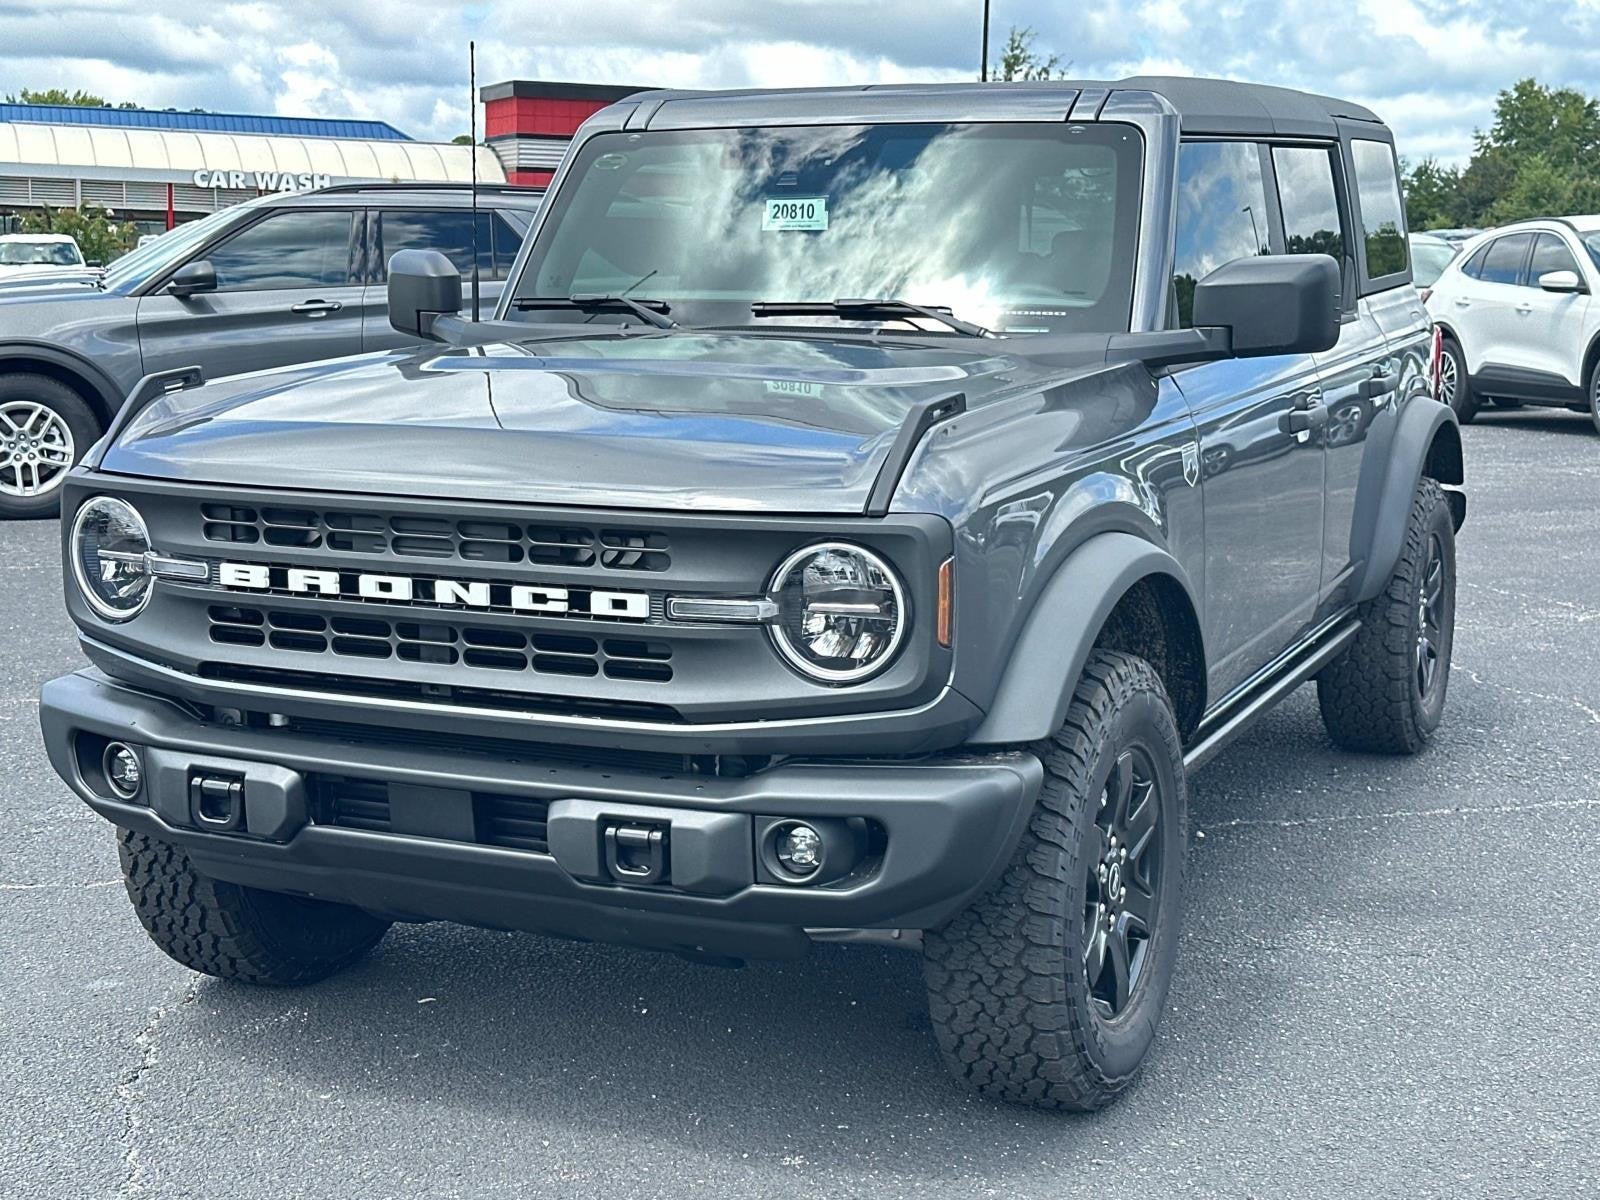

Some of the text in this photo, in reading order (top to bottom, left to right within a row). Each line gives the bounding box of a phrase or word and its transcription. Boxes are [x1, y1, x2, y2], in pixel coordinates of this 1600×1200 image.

[193, 169, 331, 192] CAR WASH
[772, 203, 815, 219] 20810
[219, 562, 650, 618] BRONCO
